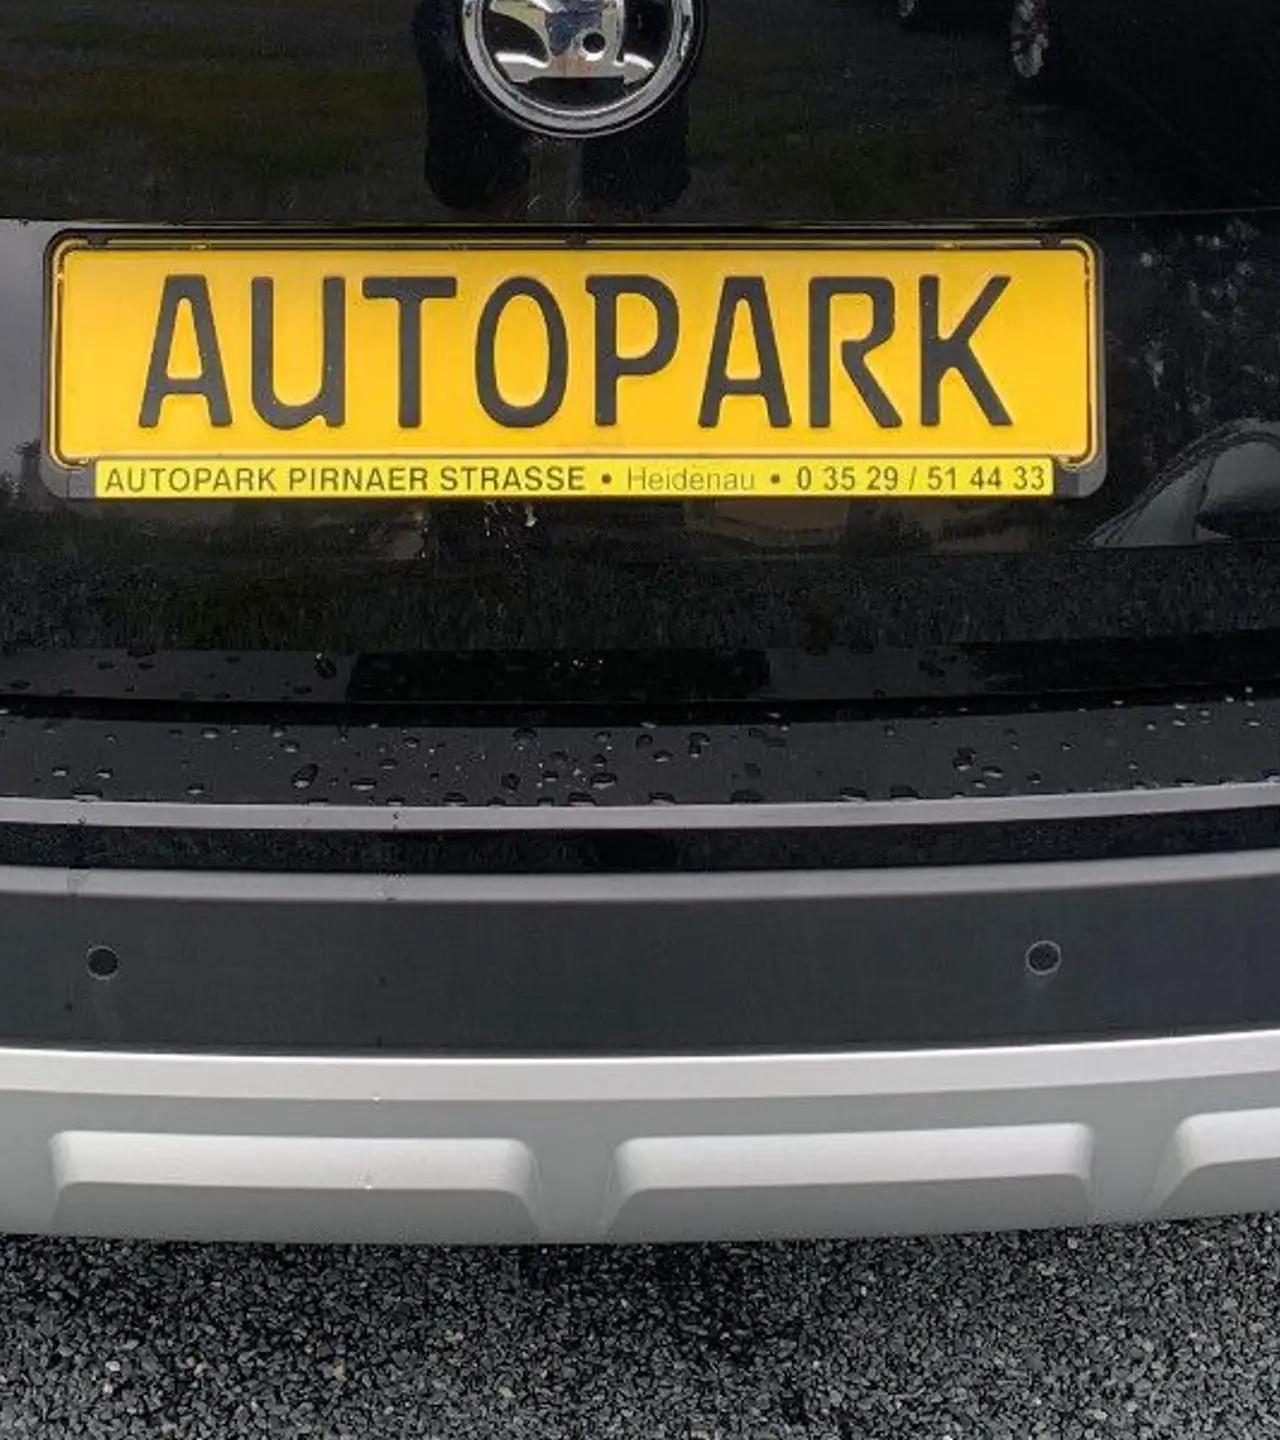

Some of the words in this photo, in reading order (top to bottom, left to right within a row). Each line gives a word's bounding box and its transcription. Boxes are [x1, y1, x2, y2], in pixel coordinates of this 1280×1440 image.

[138, 274, 1013, 429] AUTOPARK
[105, 467, 275, 492] AUTOPARK
[288, 467, 428, 491] PIRNAER
[440, 466, 586, 491] STRASSE
[627, 467, 755, 491] Heidenau
[823, 466, 856, 490] 35
[867, 466, 898, 490] 29
[927, 466, 957, 490] 51
[969, 466, 1001, 490] 44
[1013, 466, 1045, 490] 33
